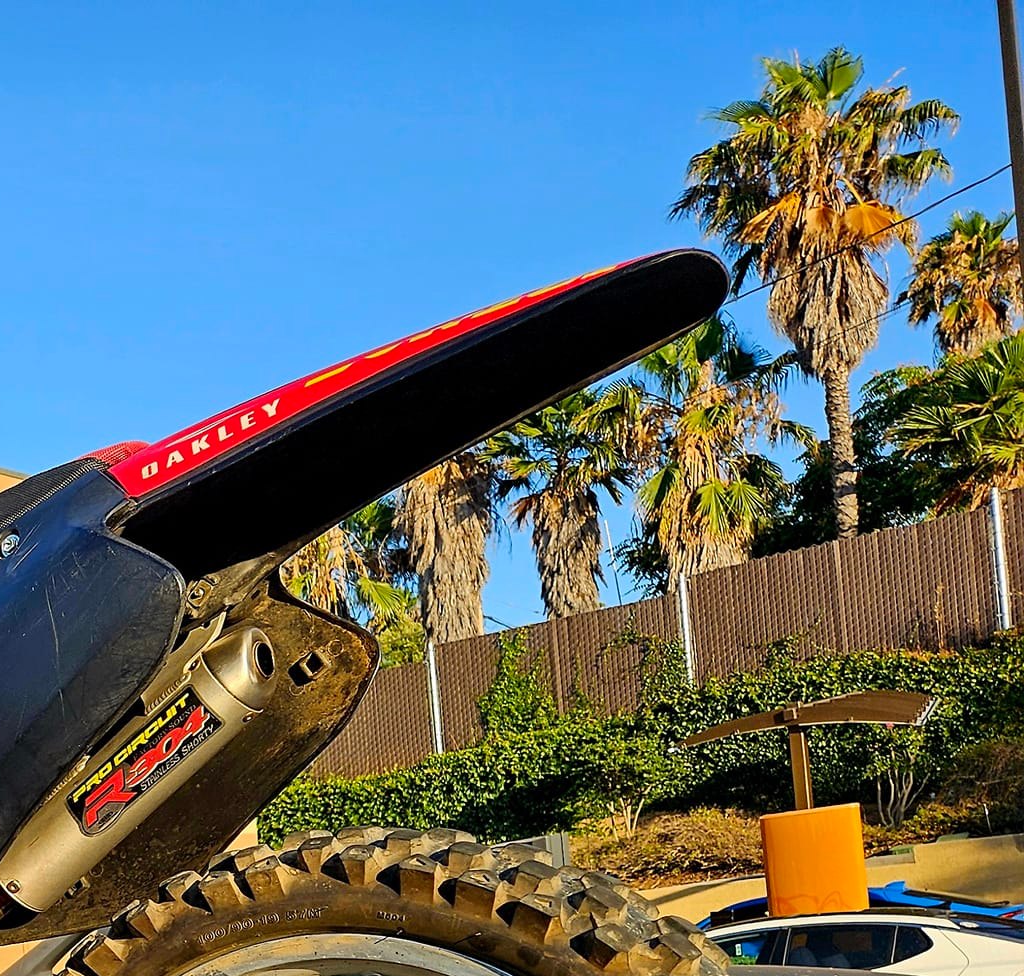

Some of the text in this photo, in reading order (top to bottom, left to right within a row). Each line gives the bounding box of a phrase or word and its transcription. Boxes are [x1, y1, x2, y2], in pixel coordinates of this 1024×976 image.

[141, 398, 280, 479] OAKLEY
[72, 693, 189, 803] PRO CIRCUIT
[140, 724, 215, 792] STAINLESS SHORTY
